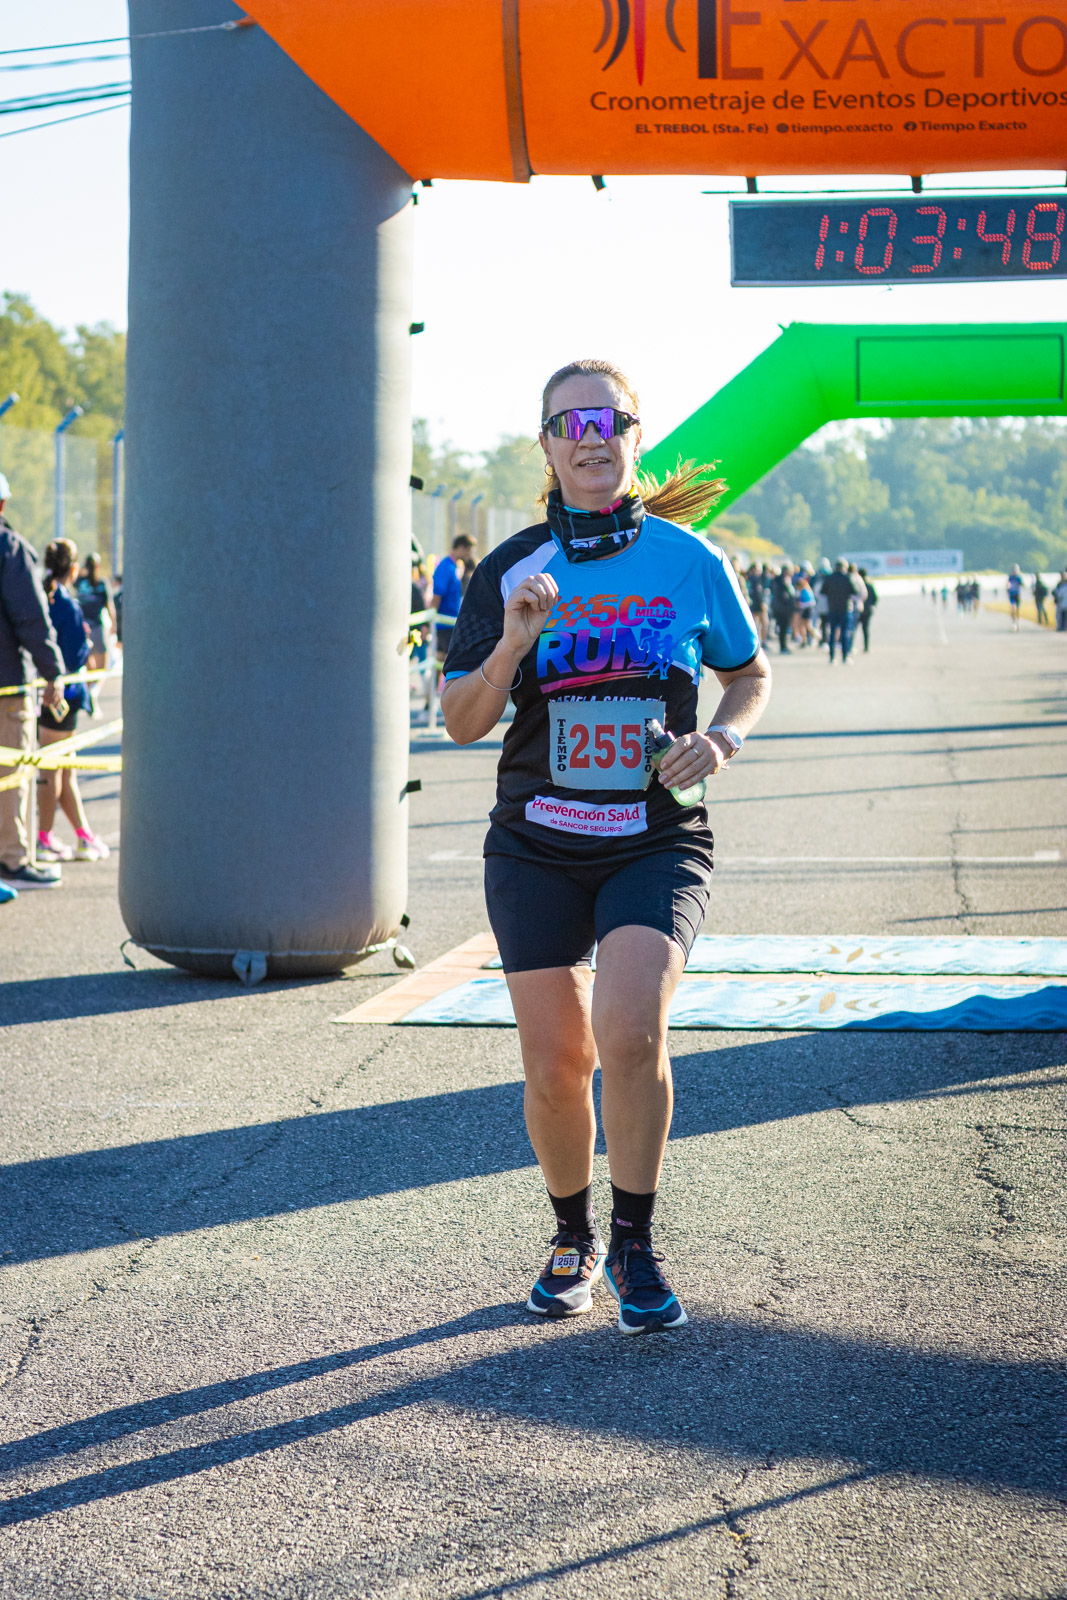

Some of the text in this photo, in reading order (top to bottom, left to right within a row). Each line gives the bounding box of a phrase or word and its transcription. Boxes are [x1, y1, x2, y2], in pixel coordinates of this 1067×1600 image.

[590, 87, 1067, 114] Cronometraje de Eventos Deportivos
[635, 120, 1027, 135] EL TREBOL (Sta. Fe) tiempo.exacto Tiempo Exacto
[814, 203, 1065, 275] 1:03:48
[635, 608, 677, 620] MILLAS
[536, 627, 653, 679] RUN
[557, 718, 567, 772] TIEMPO
[569, 723, 642, 769] 255
[532, 799, 605, 822] Prevención
[558, 820, 588, 831] SANCOR
[589, 825, 623, 833] SEGUROS
[557, 1256, 575, 1266] 255
